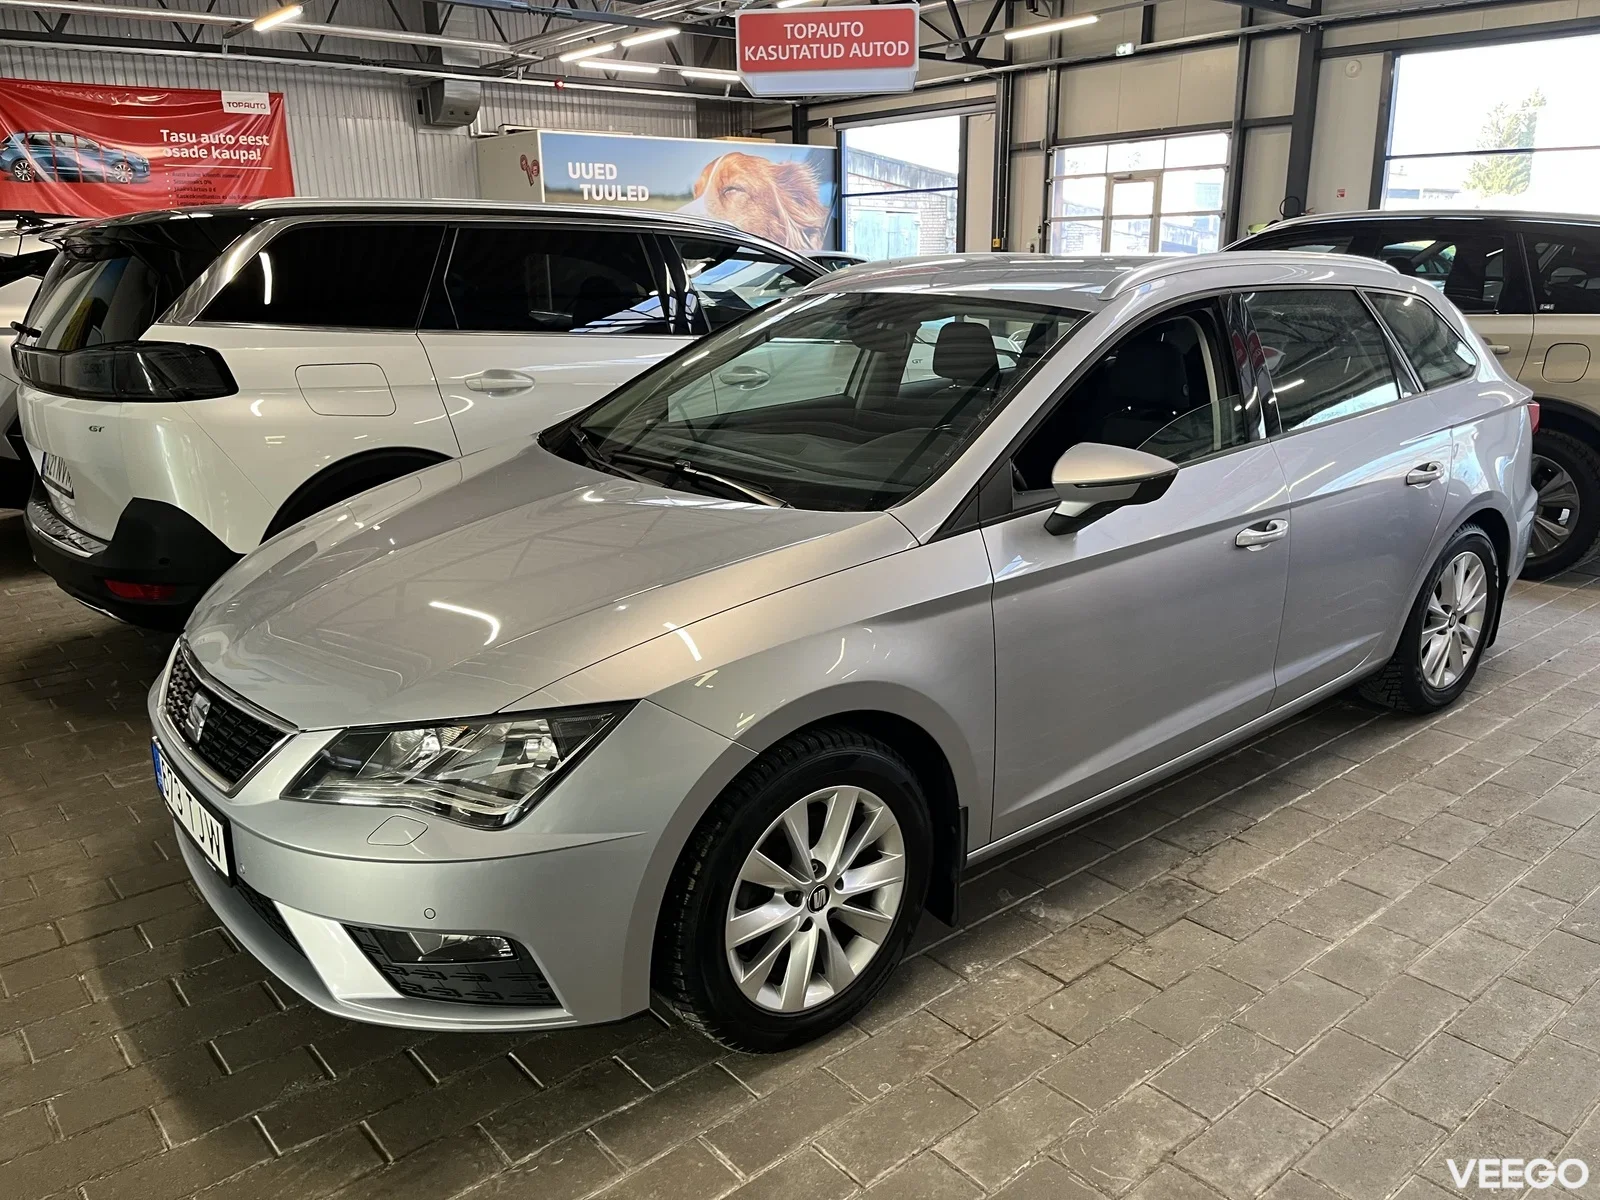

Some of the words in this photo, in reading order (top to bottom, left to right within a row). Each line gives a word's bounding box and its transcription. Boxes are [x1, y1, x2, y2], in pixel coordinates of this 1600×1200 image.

[783, 21, 864, 39] TOPAUTO
[744, 43, 845, 61] KASUTATUD
[849, 41, 910, 58] AUTOD
[226, 101, 267, 109] TOPAUTO
[160, 129, 196, 143] Tasu
[200, 133, 235, 144] auto
[239, 134, 270, 146] eest
[163, 146, 208, 158] osade
[211, 146, 262, 163] kaupa!
[567, 161, 618, 180] UUED
[579, 183, 650, 202] TUULED
